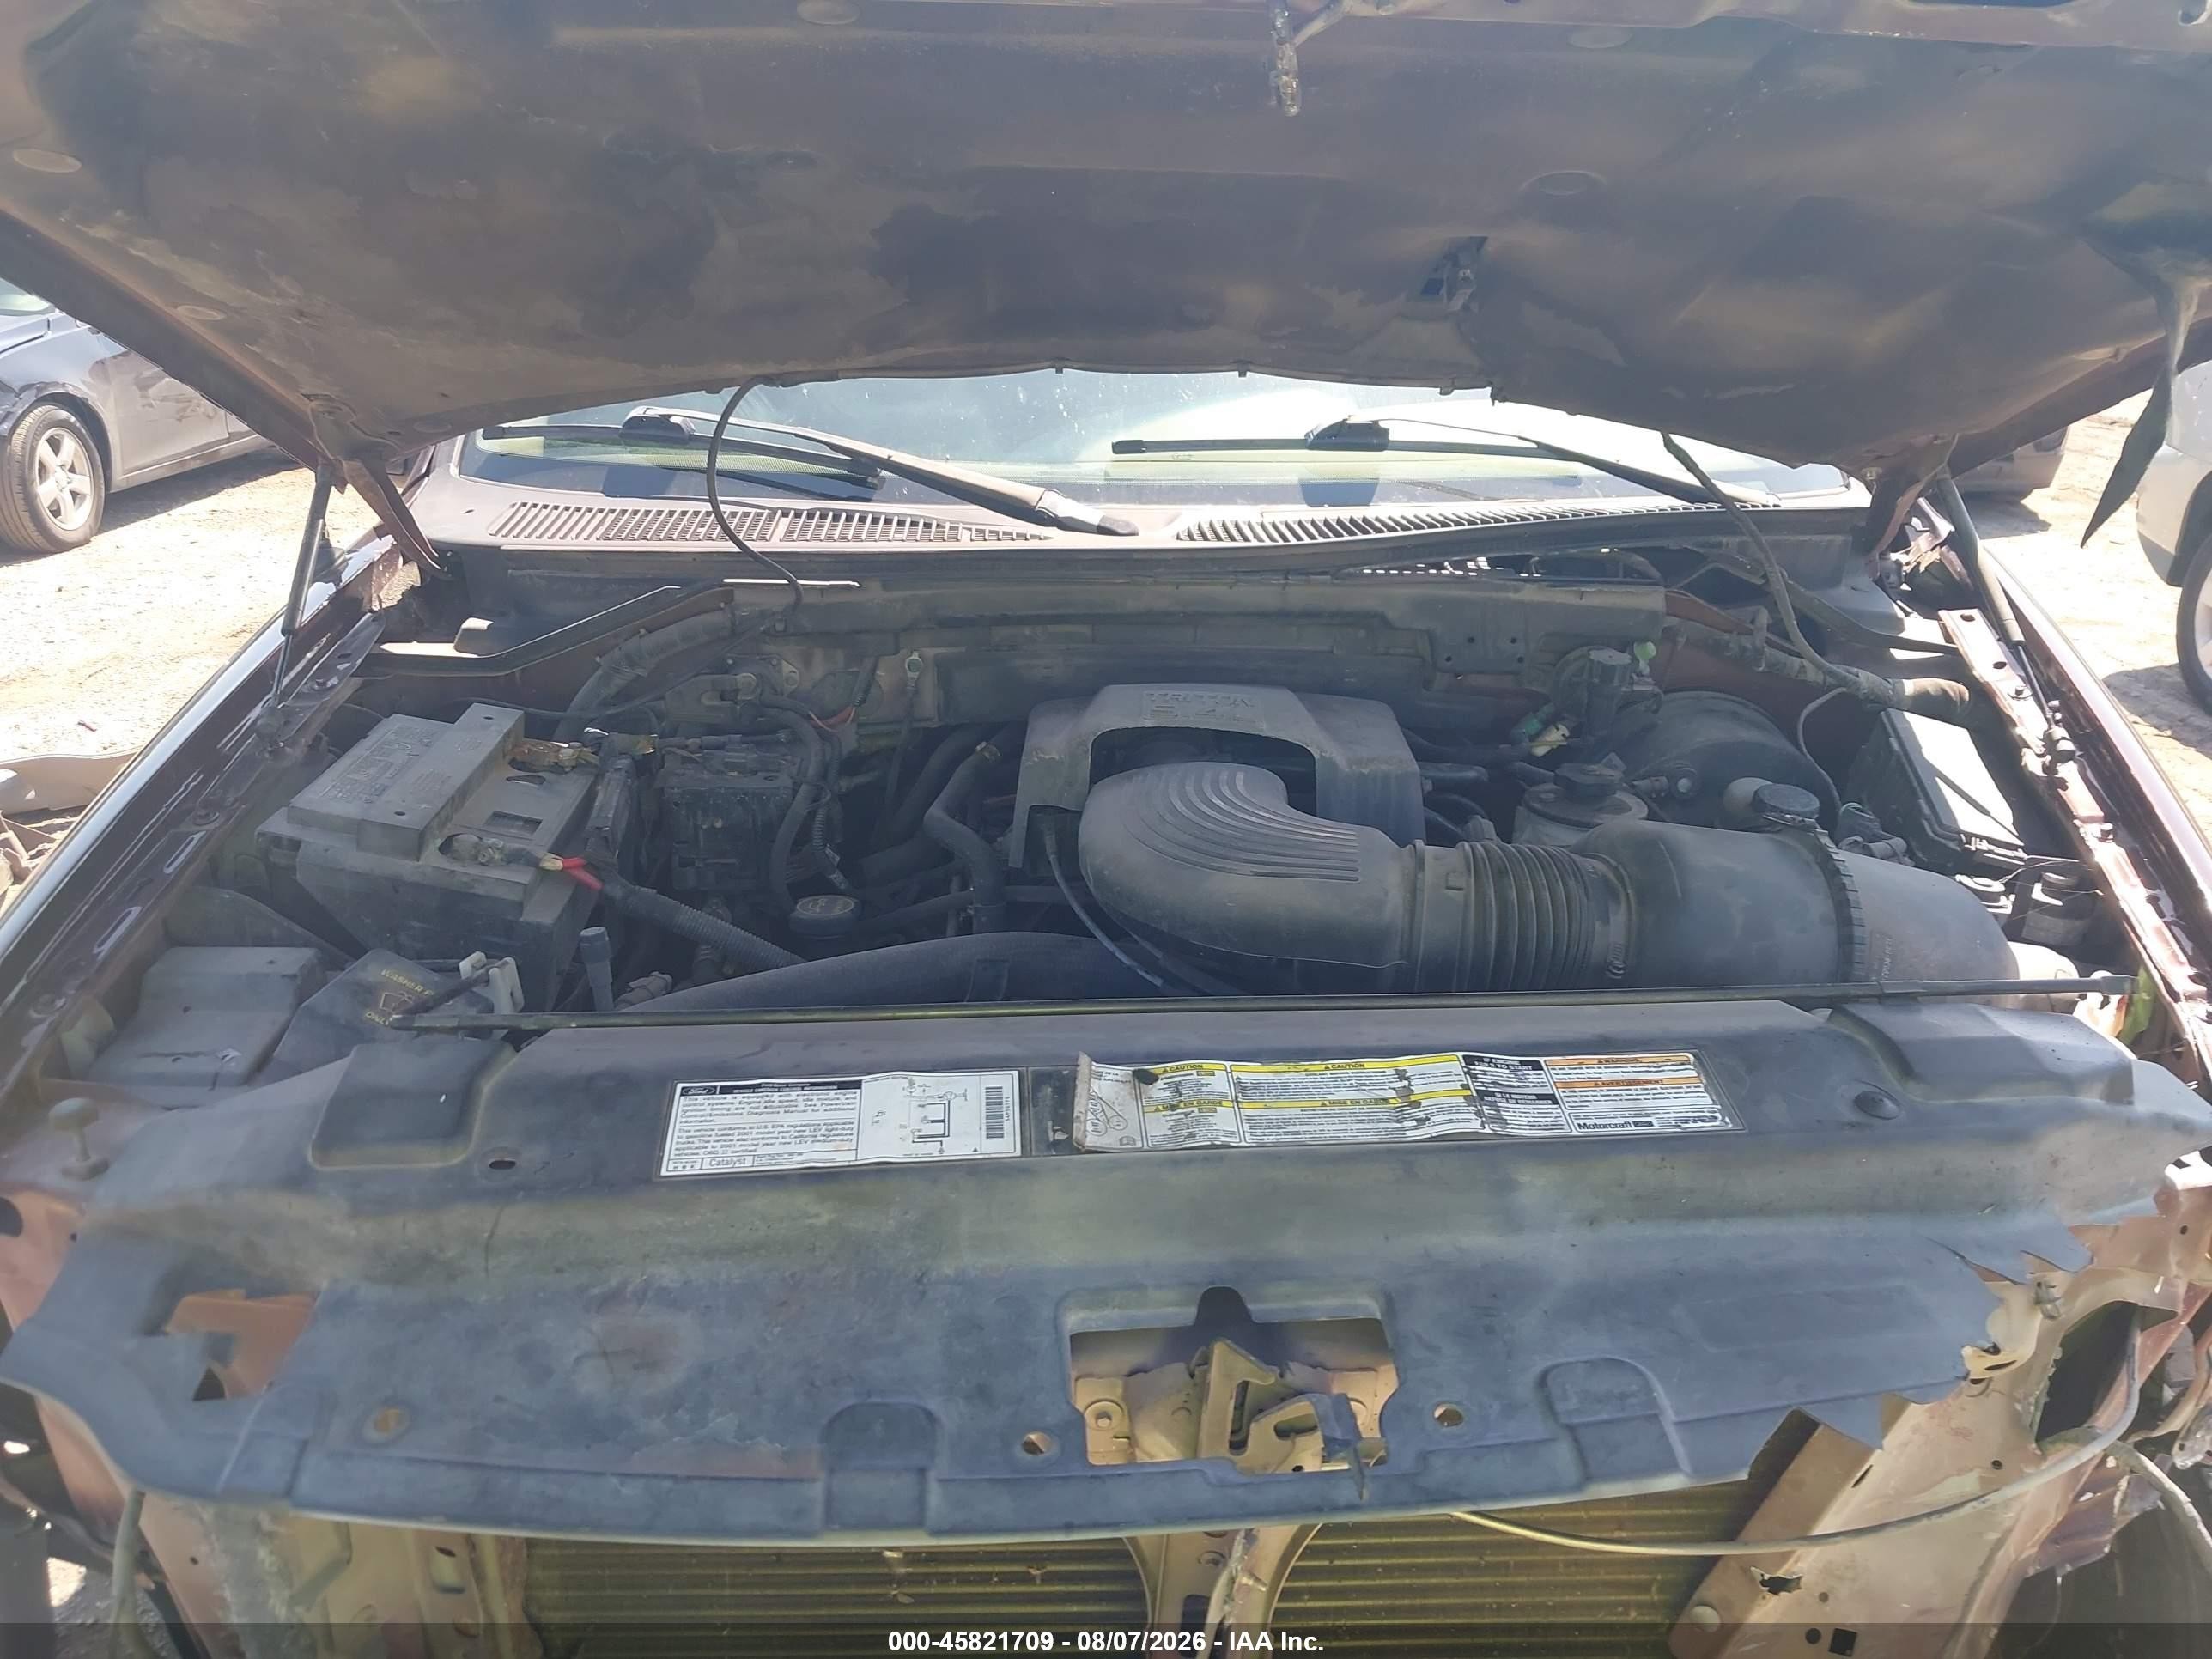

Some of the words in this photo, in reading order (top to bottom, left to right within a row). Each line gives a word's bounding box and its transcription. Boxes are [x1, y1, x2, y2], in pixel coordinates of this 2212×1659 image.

[381, 969, 423, 994] WASHER
[1577, 1121, 1633, 1130] Motorcraft
[709, 1158, 746, 1166] Catalyst
